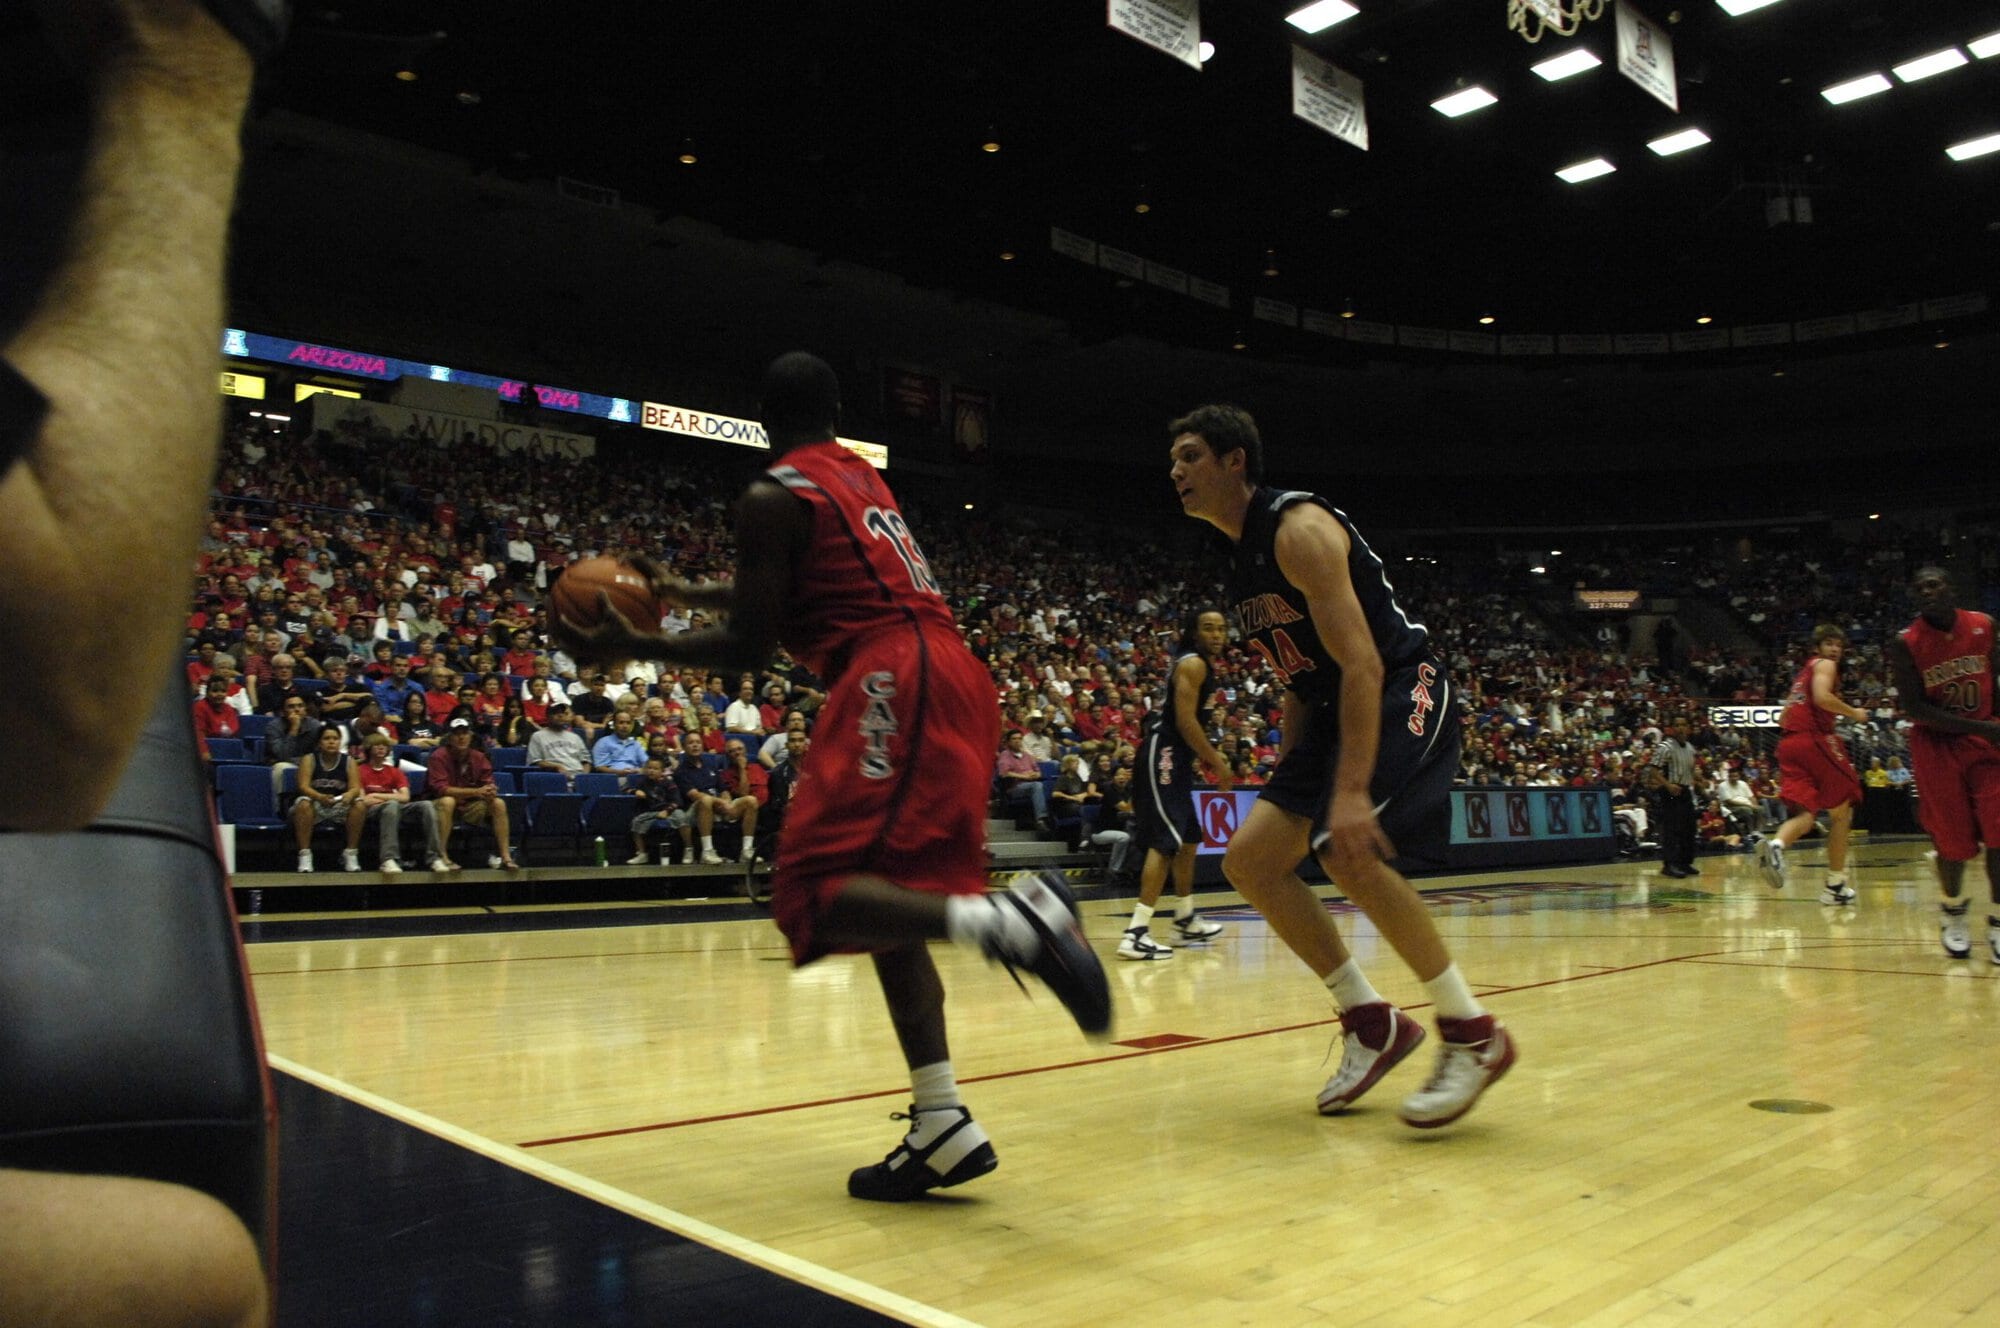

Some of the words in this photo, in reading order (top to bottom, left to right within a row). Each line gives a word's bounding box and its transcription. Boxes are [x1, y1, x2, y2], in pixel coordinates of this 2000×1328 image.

[287, 345, 386, 376] ARIZONA
[1407, 662, 1438, 737] CATS
[1942, 680, 1982, 713] 20
[858, 671, 899, 780] CATS
[1209, 802, 1234, 840] K
